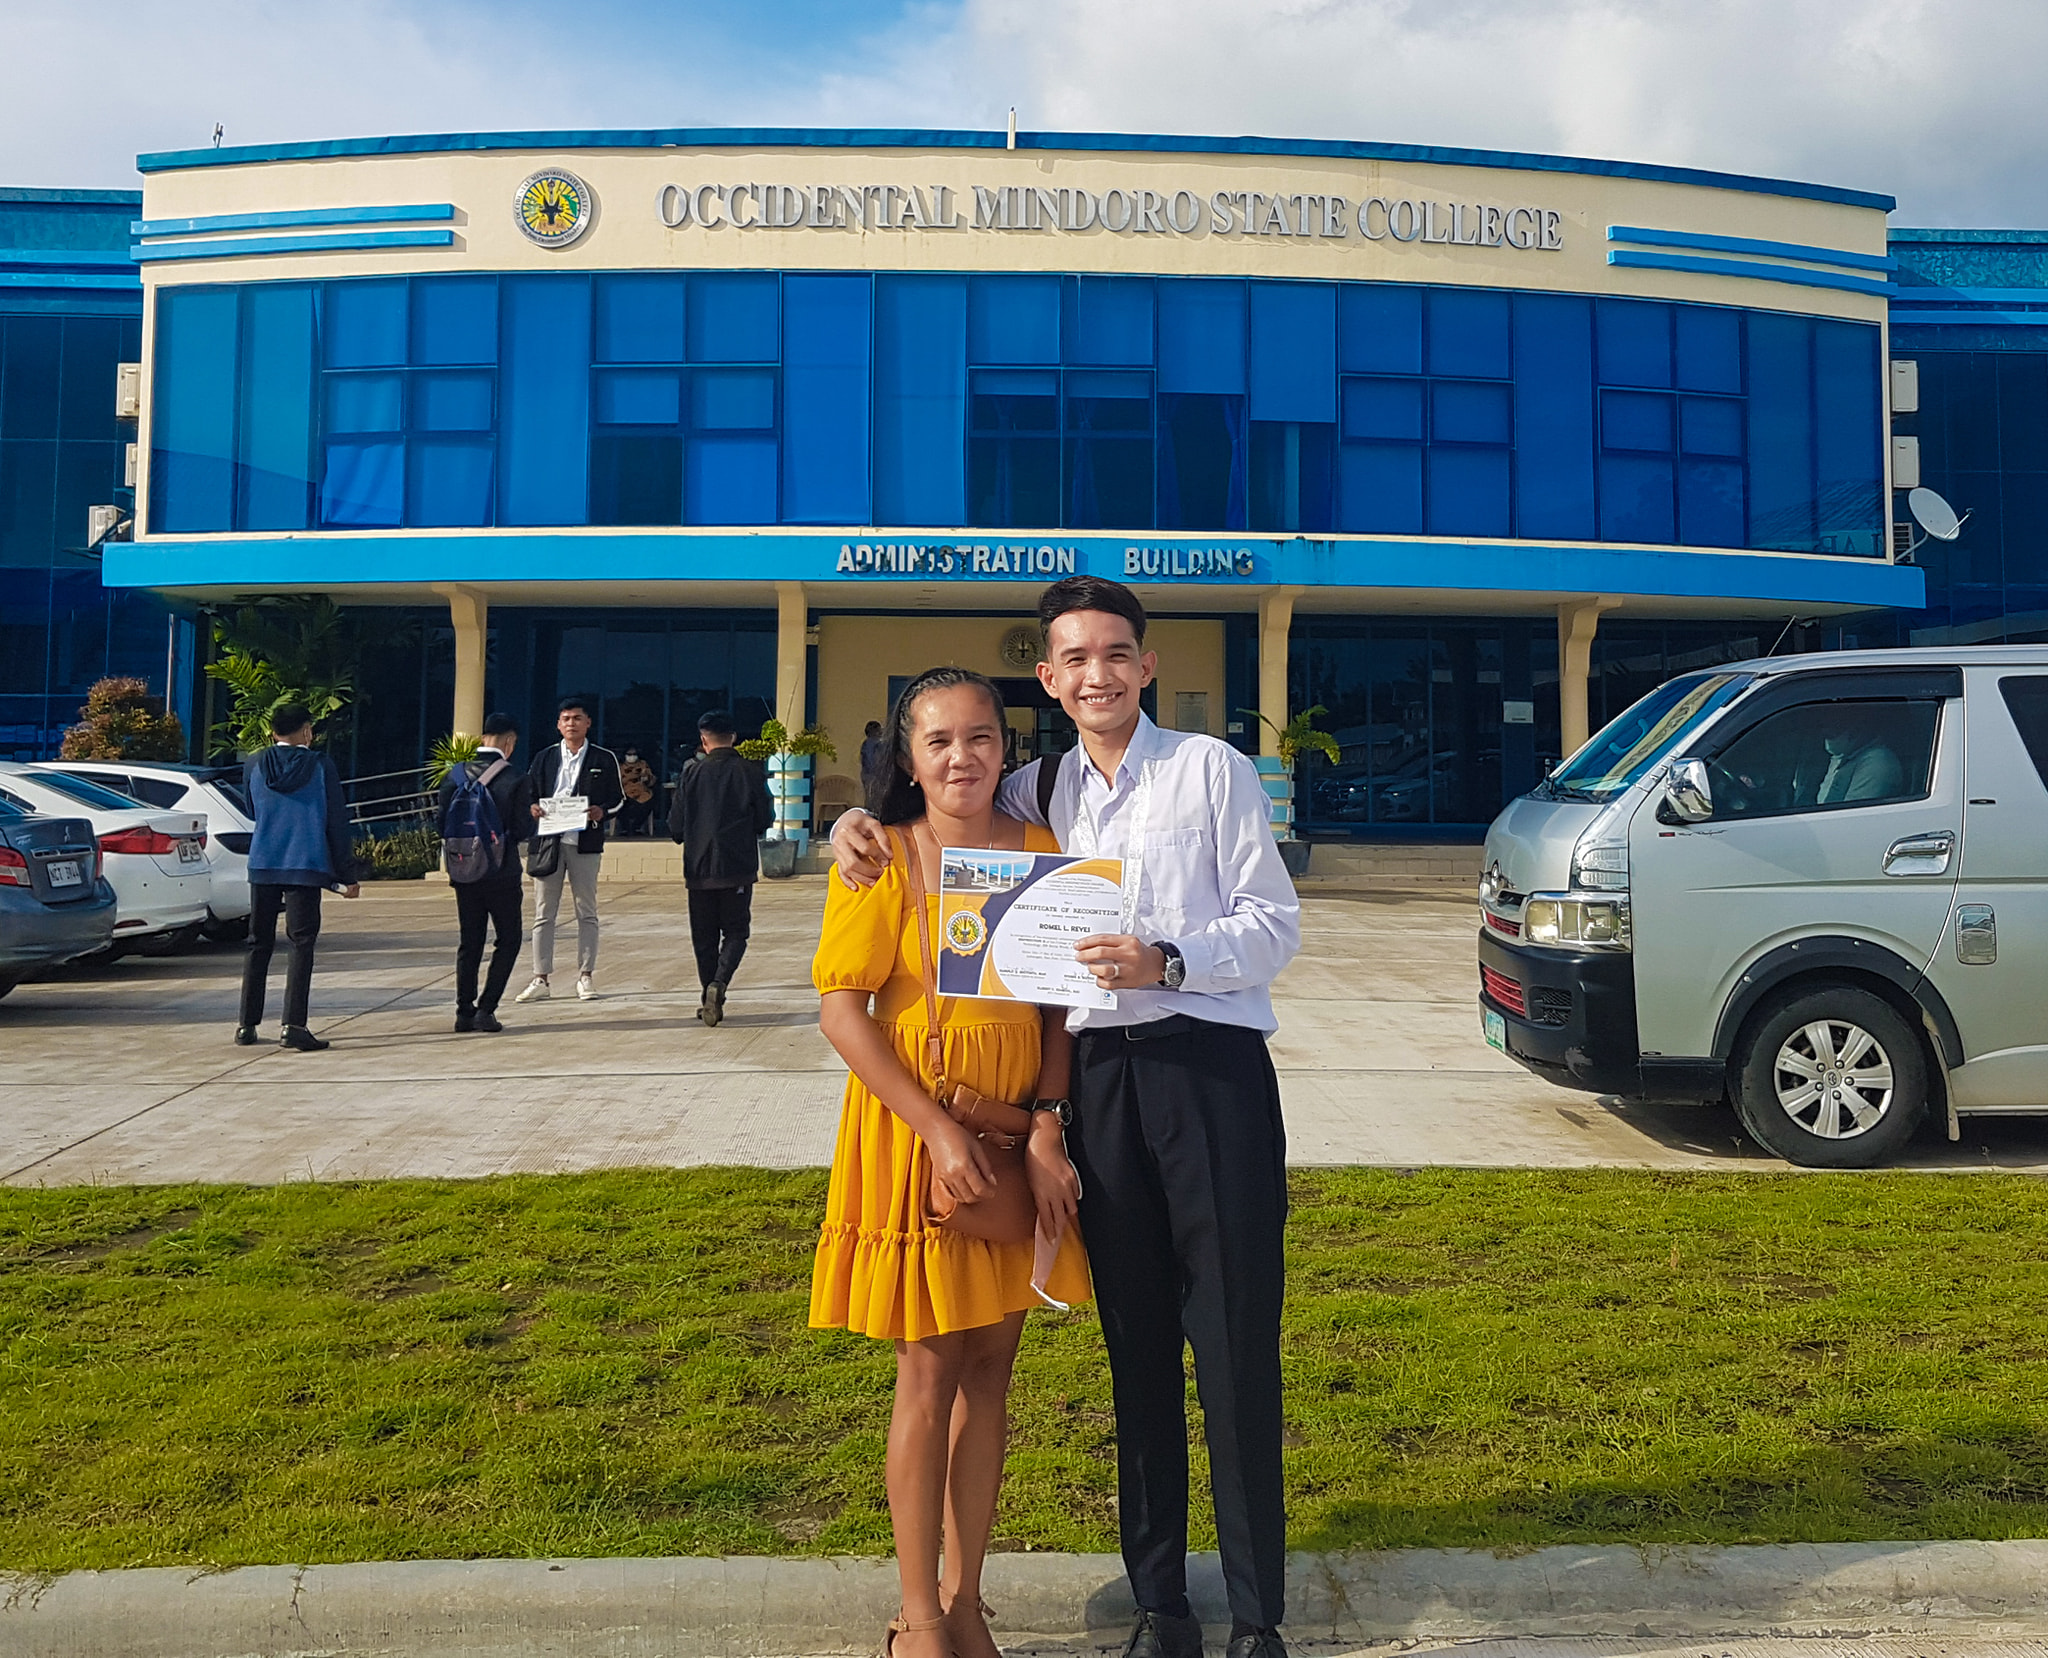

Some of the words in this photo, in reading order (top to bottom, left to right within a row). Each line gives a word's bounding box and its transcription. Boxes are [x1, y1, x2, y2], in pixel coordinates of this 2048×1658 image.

[655, 182, 957, 229] OCCIDENTAL
[970, 185, 1199, 233] MINDORO
[1209, 191, 1347, 238] STATE
[1357, 196, 1563, 251] COLLEGE
[836, 544, 1075, 574] ADMINISTRATION
[1124, 547, 1254, 576] BUILDING
[1013, 904, 1057, 913] CERTIFICATE
[1073, 908, 1119, 916] RECOGNITION
